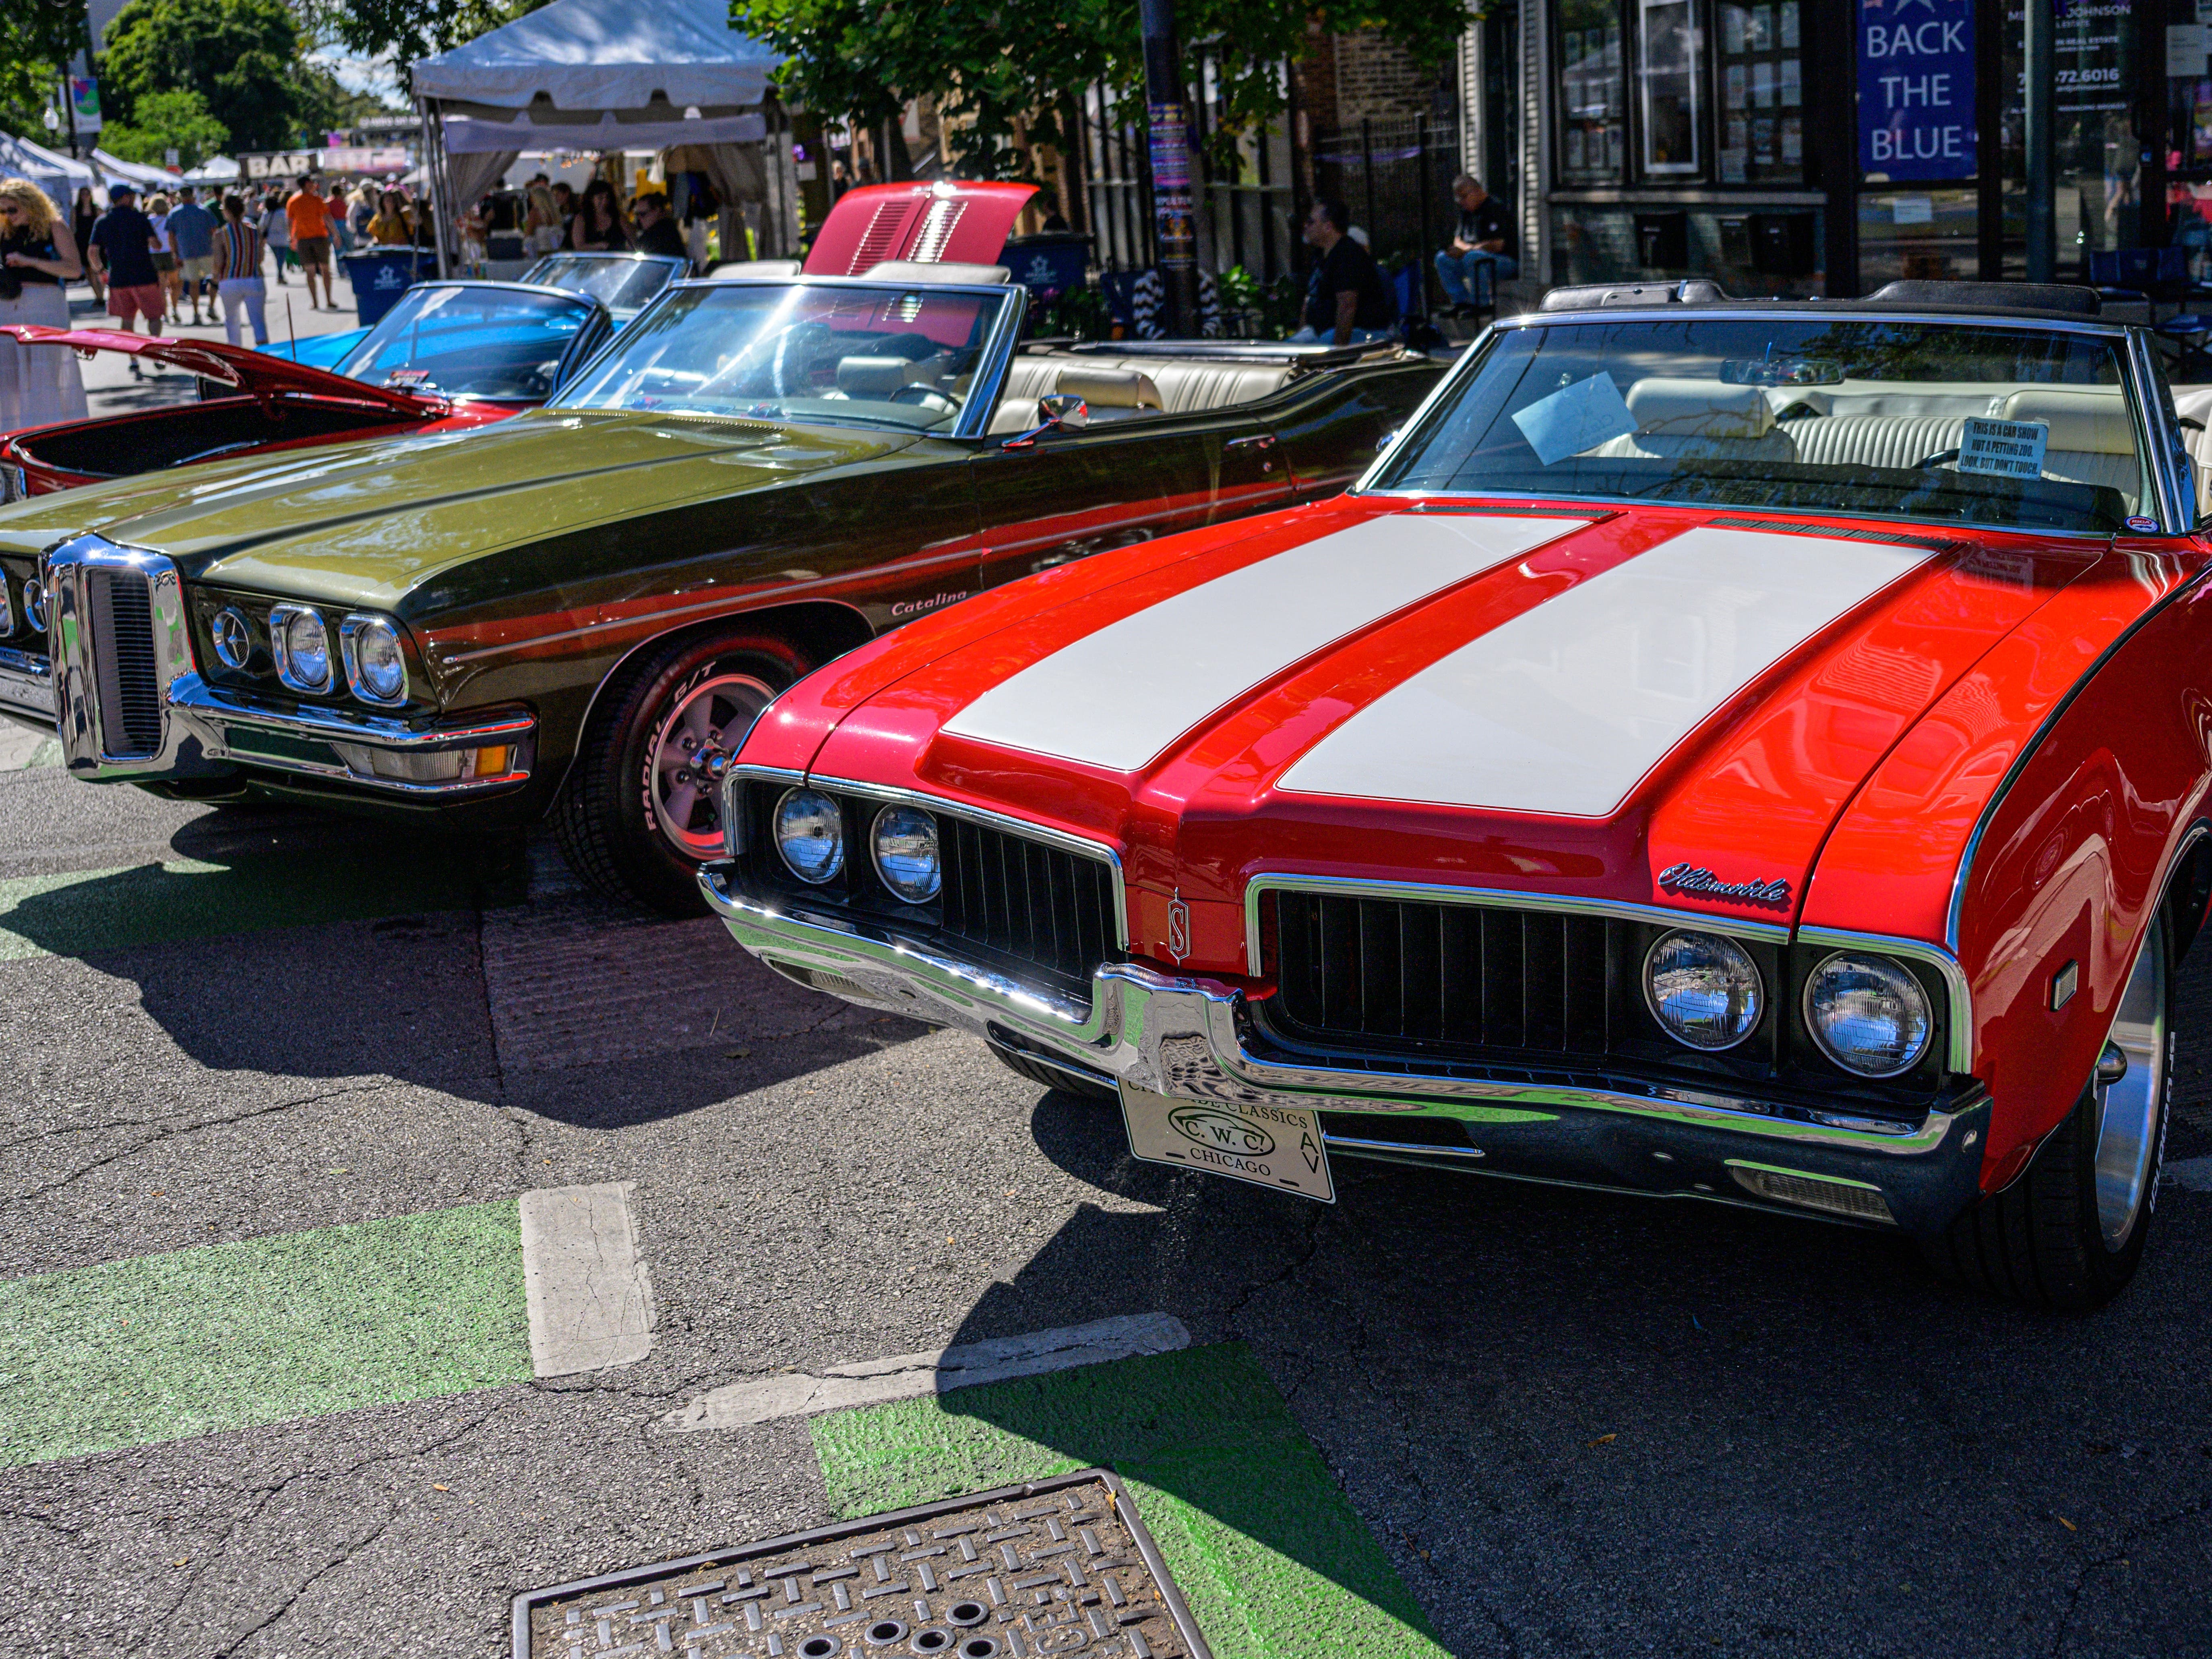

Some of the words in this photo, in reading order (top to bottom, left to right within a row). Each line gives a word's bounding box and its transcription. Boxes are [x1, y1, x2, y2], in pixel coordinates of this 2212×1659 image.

[2066, 4, 2132, 19] JOHNSON
[1867, 20, 1966, 58] BACK
[1878, 74, 1951, 108] THE
[1872, 126, 1963, 161] BLUE
[247, 155, 310, 179] BAR
[1973, 422, 1988, 435] THIS
[1989, 424, 1996, 436] IS
[1997, 425, 2002, 436] A
[2003, 426, 2017, 438] CAR
[2017, 426, 2039, 440] SHOW
[1971, 439, 1986, 451] NOT
[1985, 440, 1991, 453] A
[1991, 441, 2019, 455] PETTING
[2019, 444, 2033, 458] ZOO.
[1961, 455, 1978, 469] LOOK,
[1980, 457, 1995, 470] BUT
[1995, 459, 2015, 472] DON'T
[2015, 461, 2038, 475] TOUCH.
[891, 591, 967, 616] Catalina
[674, 661, 716, 703] G/T
[642, 717, 666, 831] RADIAL
[1658, 862, 1786, 903] Oldsmobile
[1225, 1103, 1308, 1128] CLASSICS
[1190, 1147, 1271, 1176] CHICAGO
